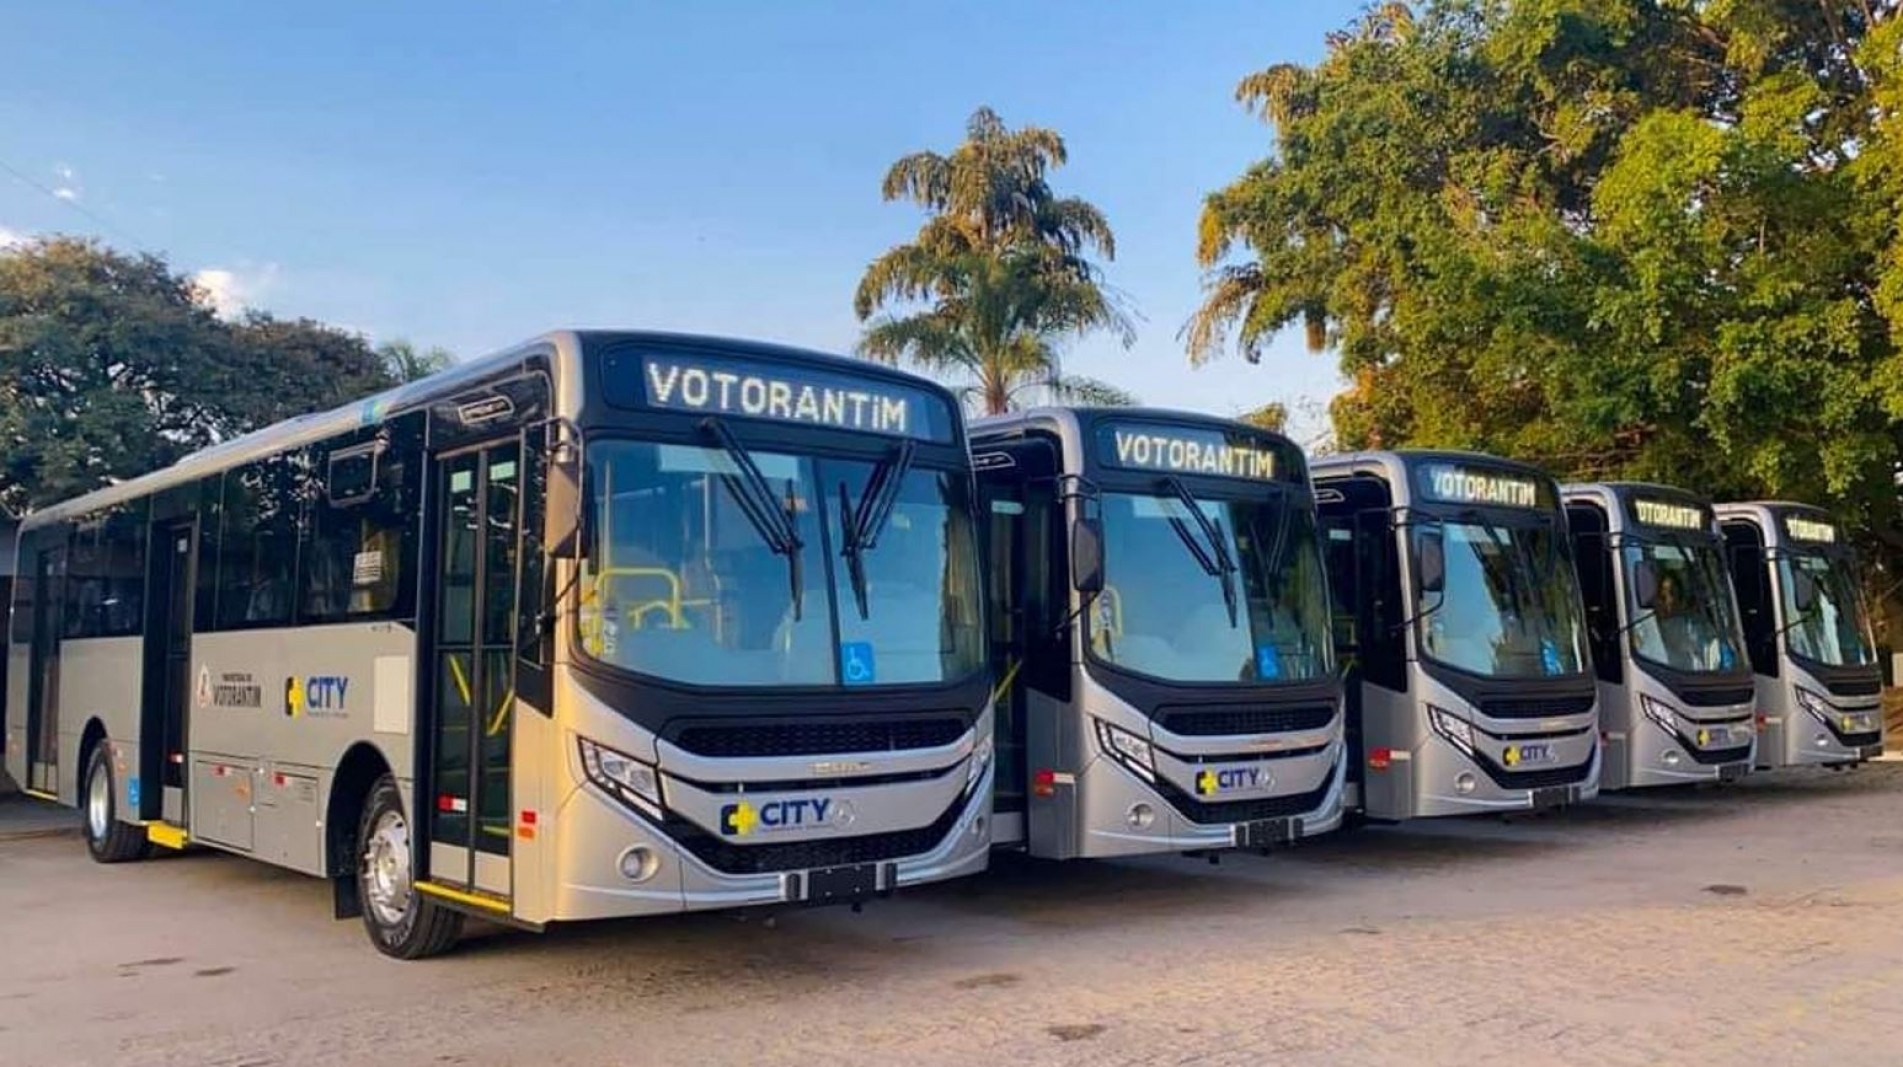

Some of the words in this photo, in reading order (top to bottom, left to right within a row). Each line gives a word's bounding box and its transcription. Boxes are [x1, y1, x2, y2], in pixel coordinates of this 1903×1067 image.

[306, 675, 349, 710] CITY
[1217, 766, 1260, 789] CITY
[759, 798, 831, 827] CITY
